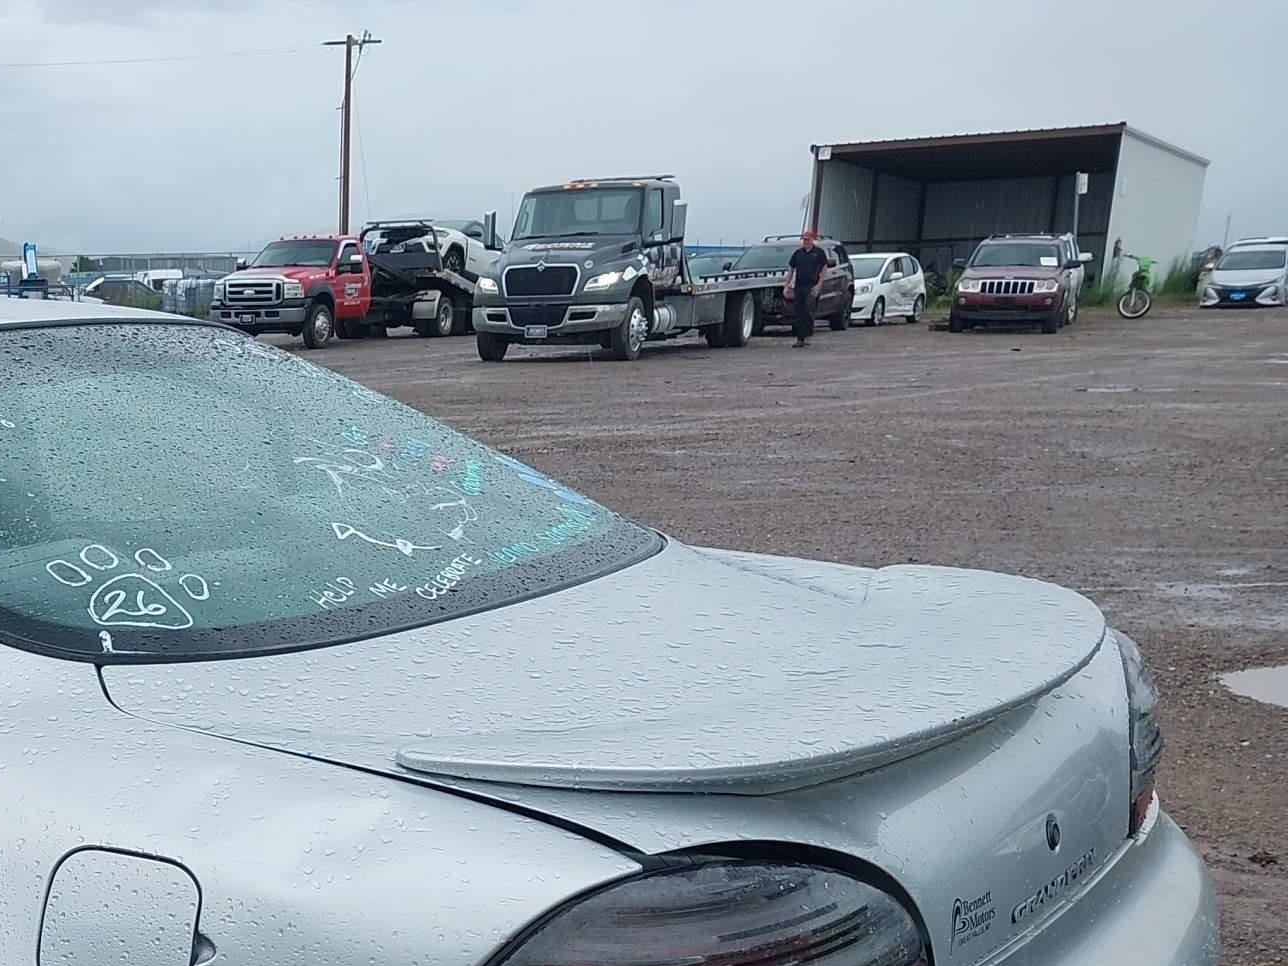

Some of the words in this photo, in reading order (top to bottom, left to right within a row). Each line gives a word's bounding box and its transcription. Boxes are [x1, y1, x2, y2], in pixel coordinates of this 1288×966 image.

[102, 589, 168, 622] 26
[961, 890, 992, 917] Bennett
[968, 907, 997, 931] Motors
